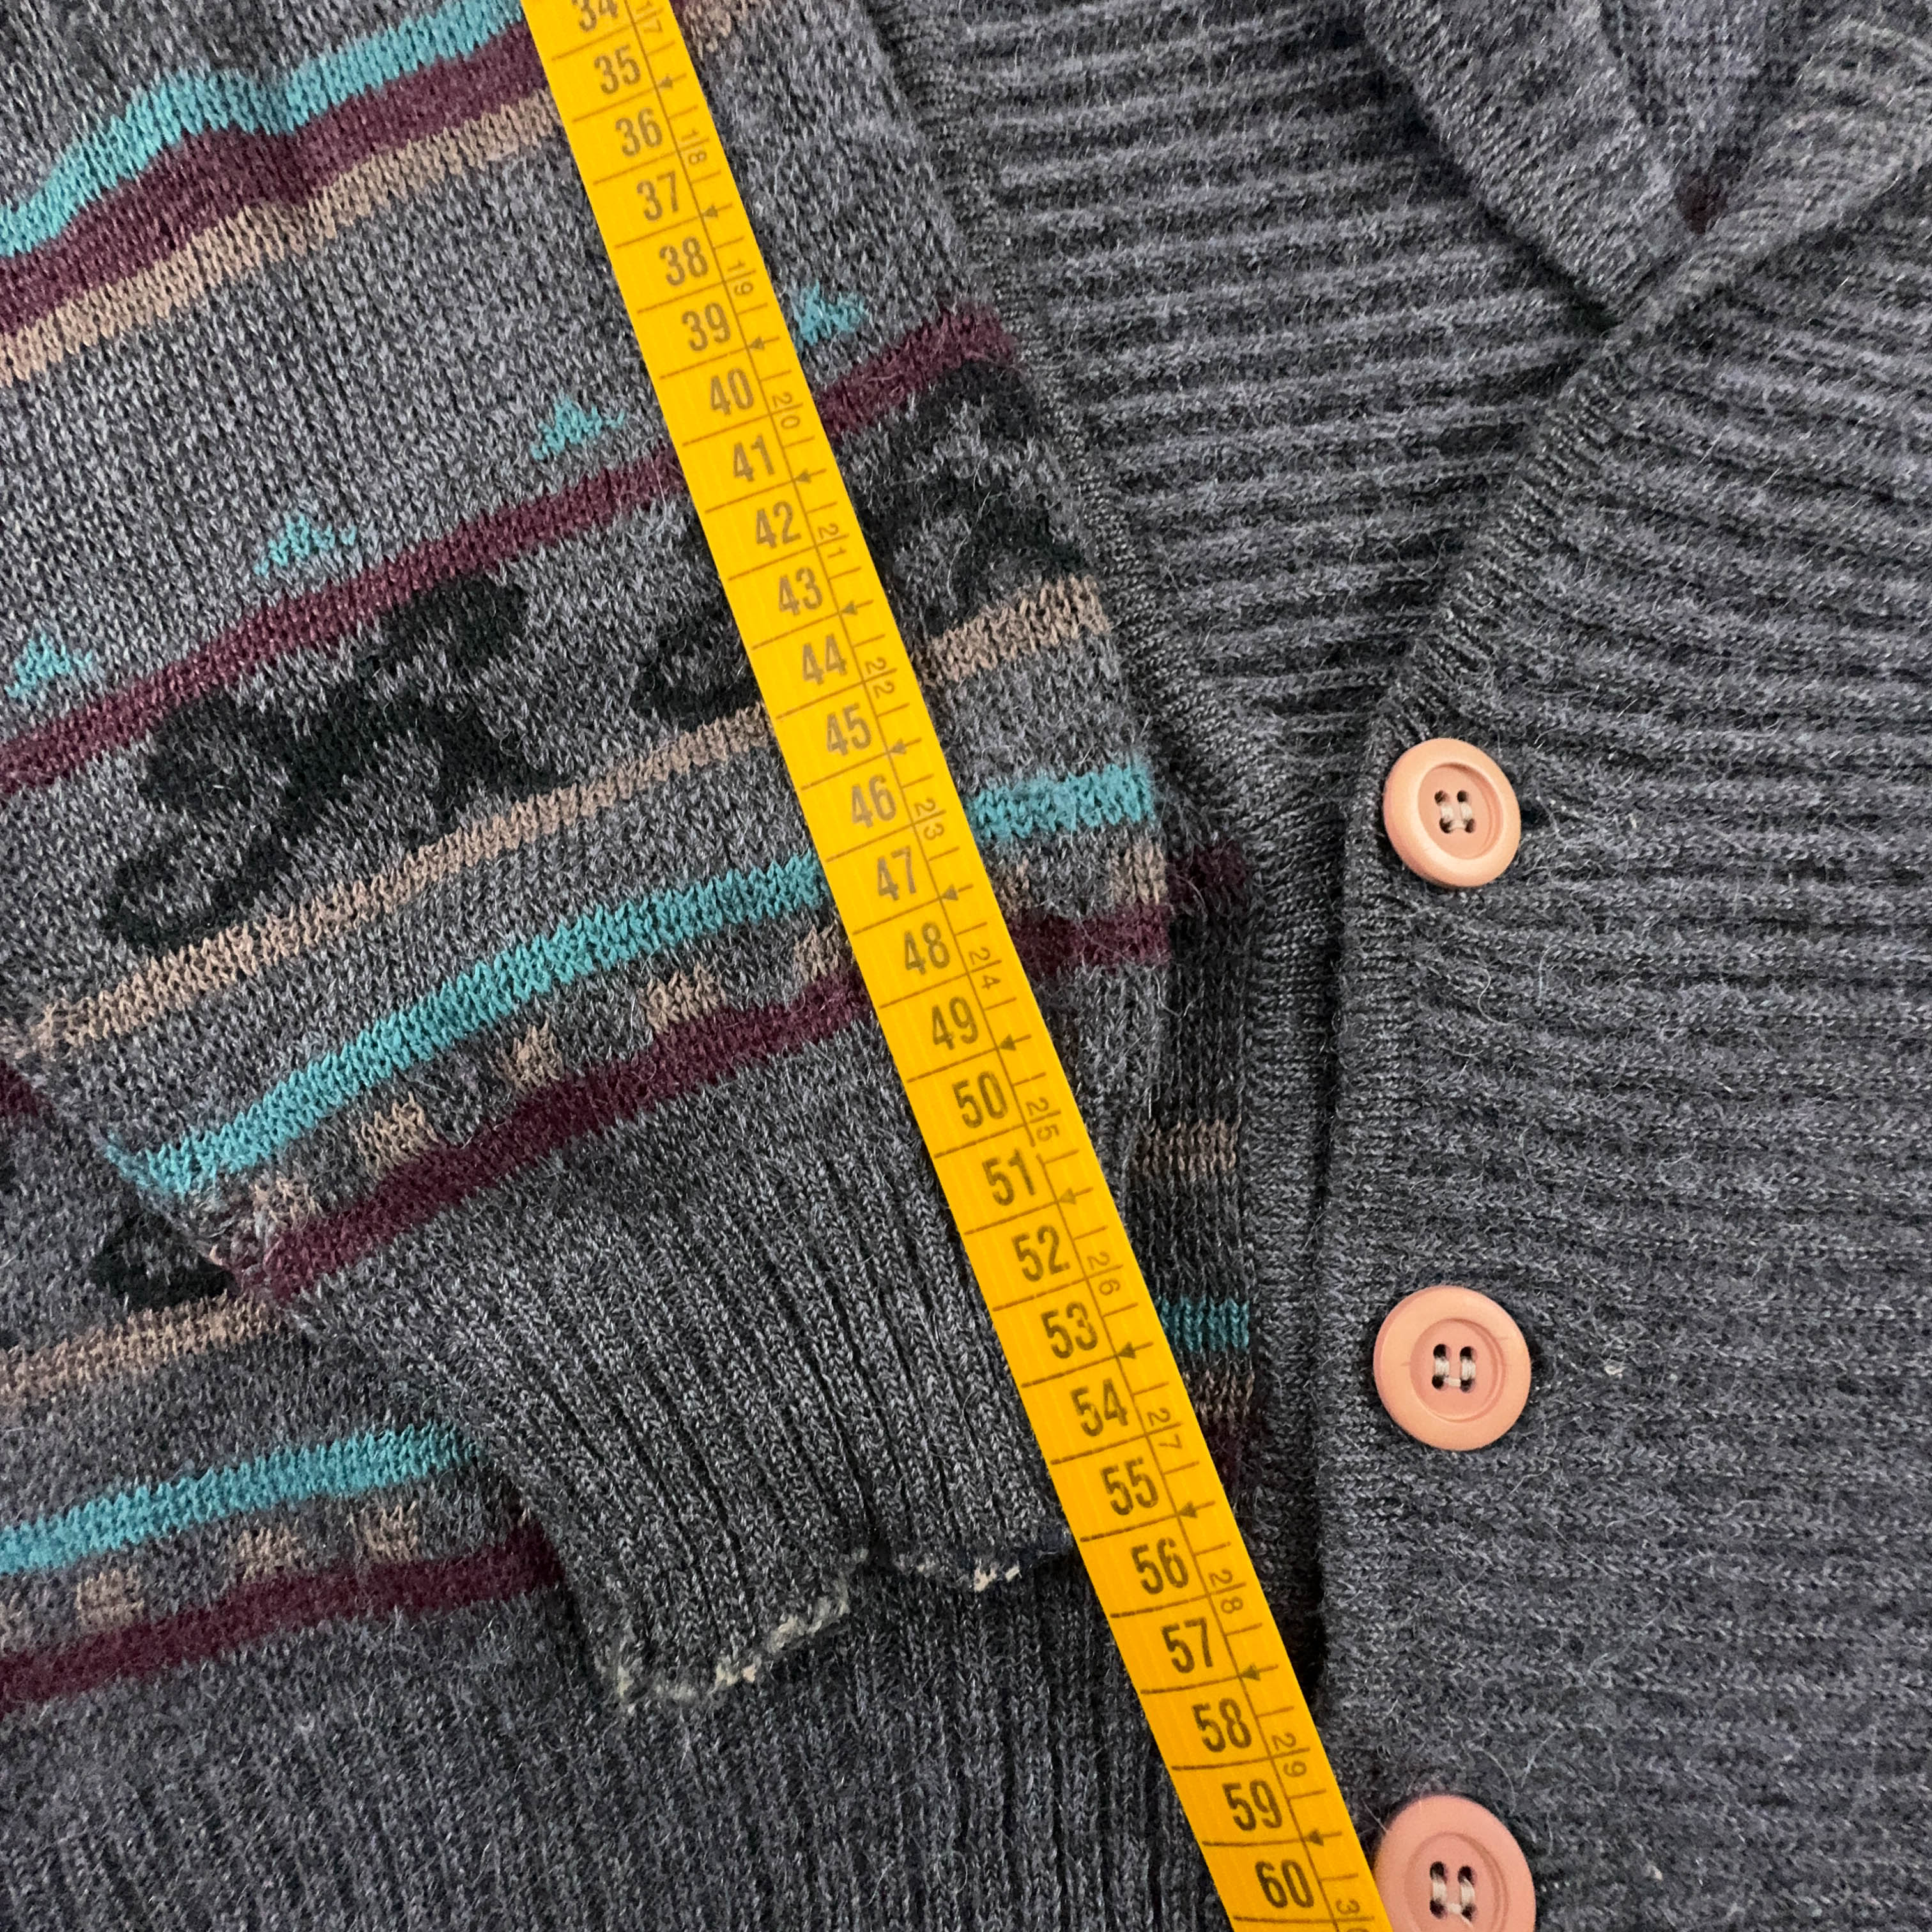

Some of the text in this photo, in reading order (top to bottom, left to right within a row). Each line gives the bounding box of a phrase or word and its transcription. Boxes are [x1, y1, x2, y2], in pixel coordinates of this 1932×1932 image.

[594, 45, 641, 95] 35
[615, 107, 663, 157] 36
[636, 171, 680, 222] 37
[659, 236, 709, 286] 38
[682, 302, 731, 351] 39
[710, 368, 755, 416] 40
[733, 435, 774, 482] 41
[755, 501, 801, 549] 42
[778, 567, 823, 616] 43
[802, 634, 847, 685] 44
[825, 703, 871, 756] 45
[850, 774, 896, 827] 46
[877, 846, 917, 901] 47
[903, 922, 951, 976] 48
[931, 996, 979, 1051] 49
[952, 1071, 1008, 1129] 50
[982, 1148, 1036, 1206] 51
[1011, 1225, 1070, 1282] 52
[1040, 1302, 1099, 1360] 53
[1070, 1379, 1128, 1438] 54
[1100, 1457, 1159, 1516] 55
[1130, 1538, 1190, 1595] 56
[1160, 1617, 1215, 1674] 57
[1191, 1698, 1252, 1753] 58
[1222, 1778, 1284, 1832] 59
[1254, 1859, 1315, 1909] 60
[1335, 1898, 1370, 1932] 3
